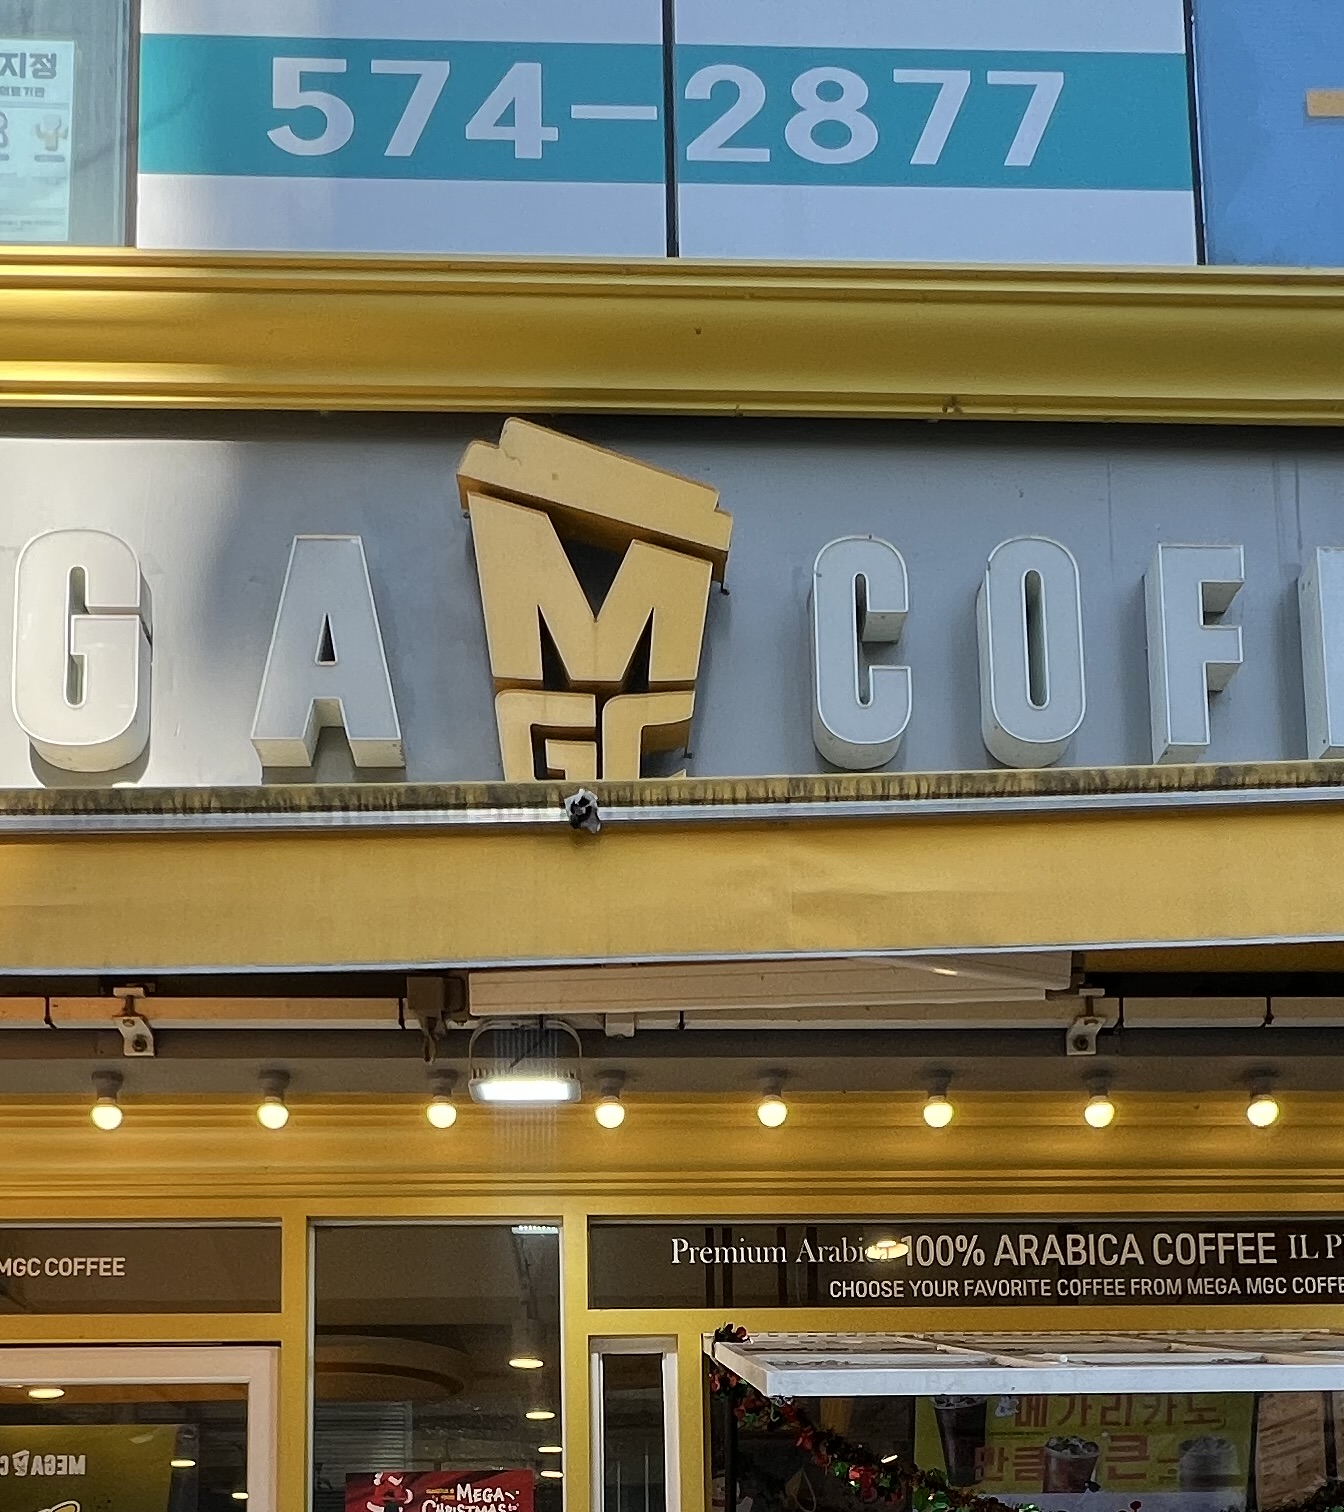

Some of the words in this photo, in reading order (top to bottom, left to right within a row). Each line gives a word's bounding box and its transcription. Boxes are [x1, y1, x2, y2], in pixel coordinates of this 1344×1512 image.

[671, 1237, 788, 1265] Premium
[901, 1234, 986, 1267] 100%
[993, 1234, 1144, 1267] ARABICA
[1152, 1232, 1278, 1266] COFFEE
[1288, 1233, 1319, 1260] IL
[44, 1257, 126, 1277] COFFEE
[829, 1279, 905, 1298] CHOOSE
[908, 1279, 959, 1297] YOUR
[963, 1278, 1052, 1297] FAVORITE
[1056, 1278, 1126, 1297] COFFEE
[1131, 1277, 1183, 1296] FROM
[1186, 1277, 1242, 1296] MEGA
[1245, 1277, 1287, 1295] MGC
[456, 1483, 505, 1503] MEGA
